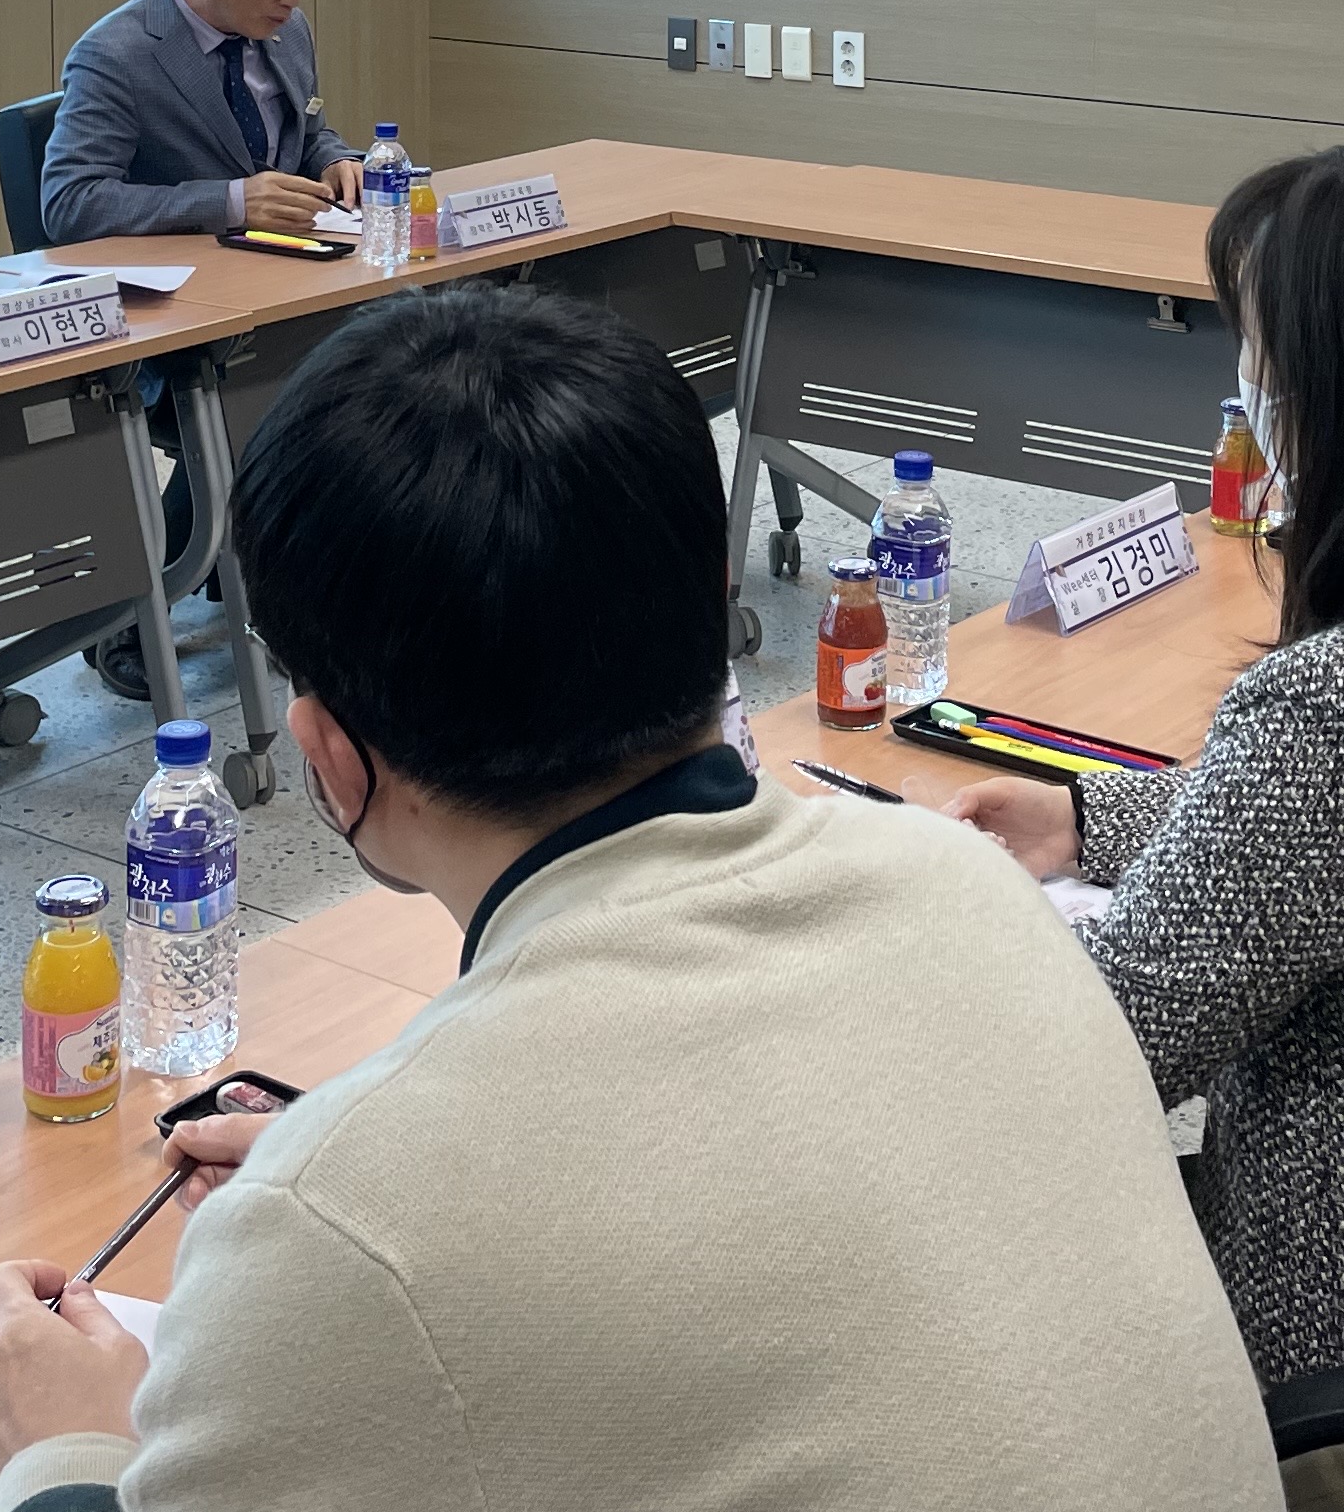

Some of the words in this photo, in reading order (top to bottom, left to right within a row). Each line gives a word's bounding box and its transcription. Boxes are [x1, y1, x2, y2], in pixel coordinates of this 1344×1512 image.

[491, 199, 551, 234] 박시동
[1, 287, 83, 315] 경상남도교육청
[23, 302, 107, 346] 이현정
[1075, 507, 1147, 550] 거창교육지원청
[1059, 567, 1101, 596] Wee센터
[1097, 527, 1180, 600] 김경민
[128, 862, 174, 903] 광천수
